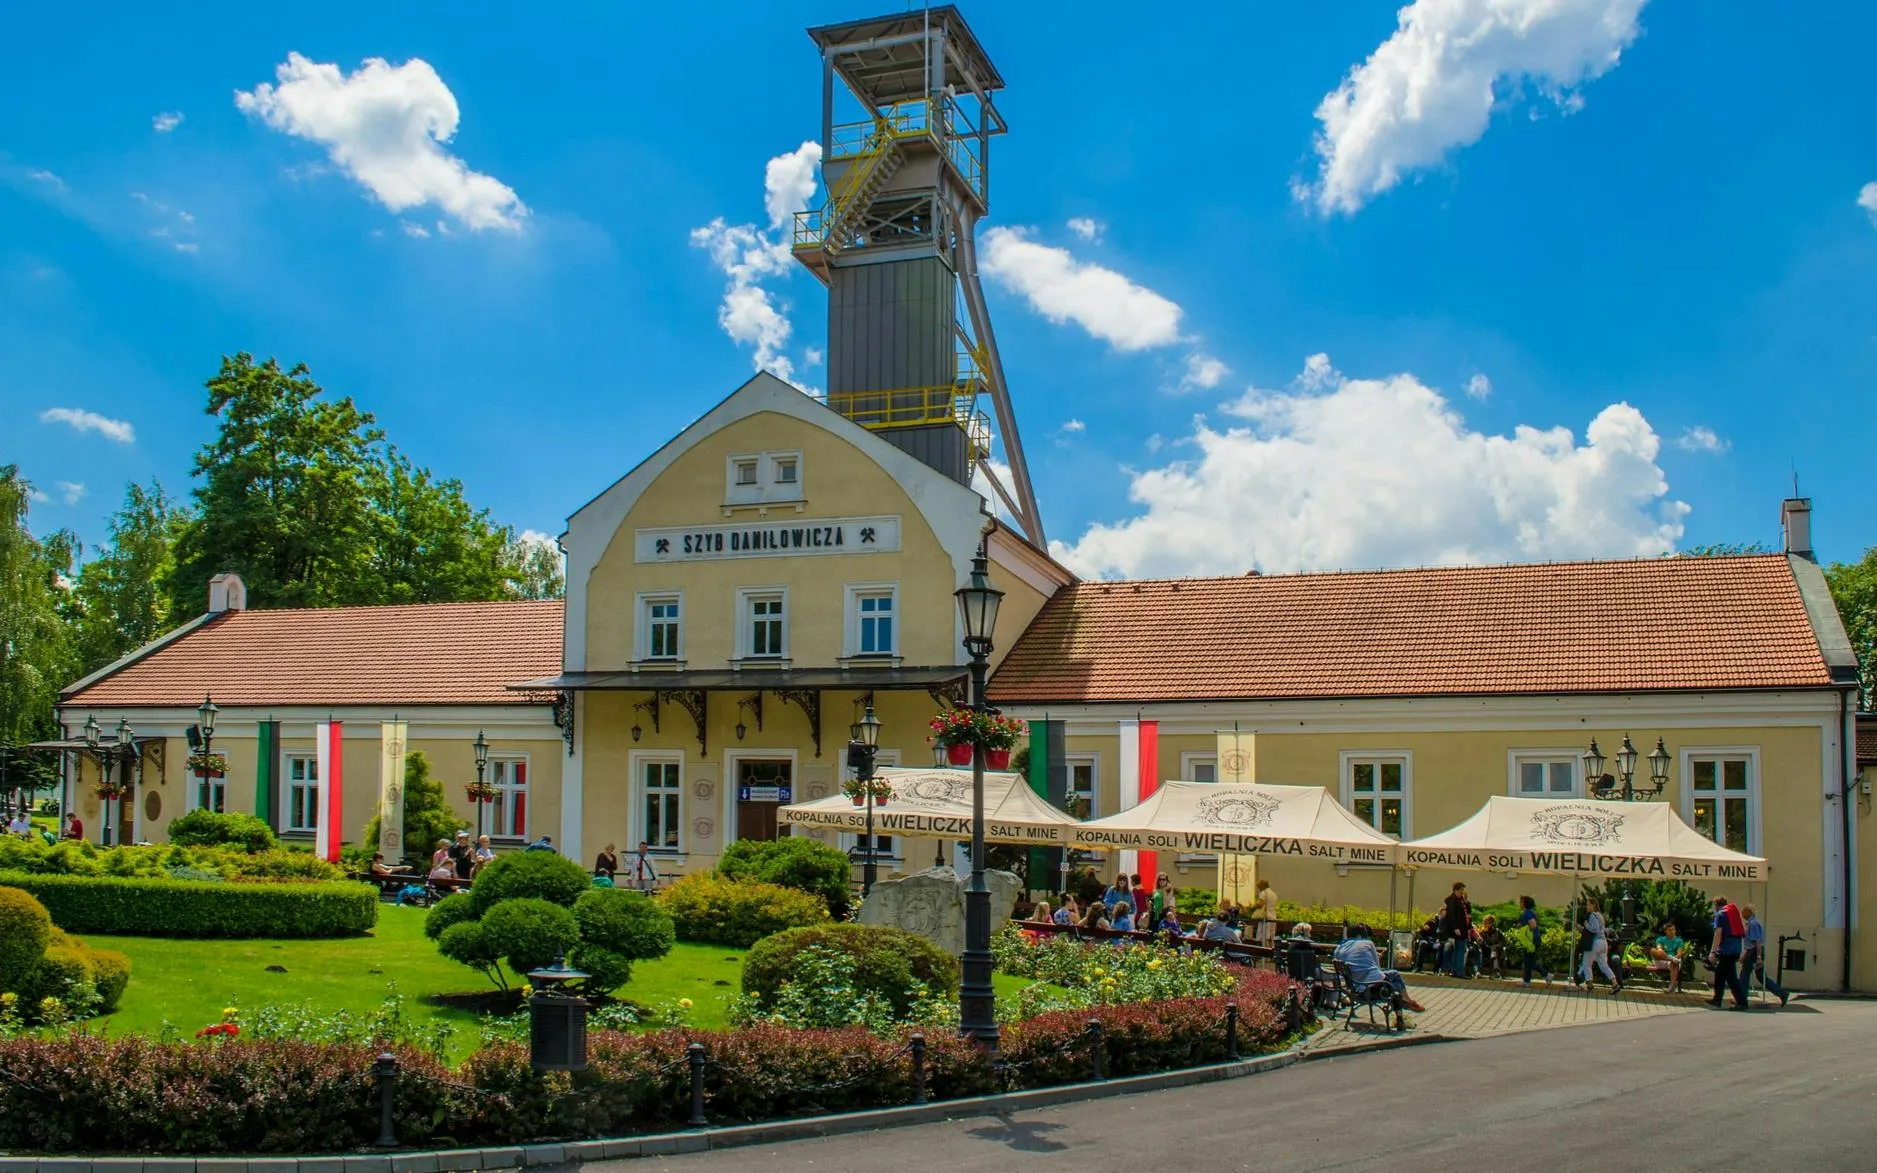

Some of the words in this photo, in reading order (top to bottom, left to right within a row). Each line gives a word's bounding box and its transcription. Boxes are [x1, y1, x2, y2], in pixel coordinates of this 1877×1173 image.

[684, 533, 723, 553] SZYB
[732, 527, 843, 550] DANIŁOWICZA
[786, 810, 842, 825] KOPALNIA
[881, 814, 986, 837] WIELICZK
[990, 825, 1021, 837] SALT
[1026, 828, 1058, 840] MINE
[1076, 830, 1142, 846] KOPALNIA
[1147, 835, 1178, 848] SOLI
[1185, 833, 1303, 855] WIELICZKA
[1309, 844, 1345, 859] SALT
[1350, 847, 1386, 862] MINE
[1406, 850, 1482, 867] KOPALNIA
[1488, 854, 1523, 869] SOLI
[1530, 851, 1665, 875] WIELICZKA
[1671, 863, 1712, 877] SALT
[1718, 865, 1758, 879] MINE
